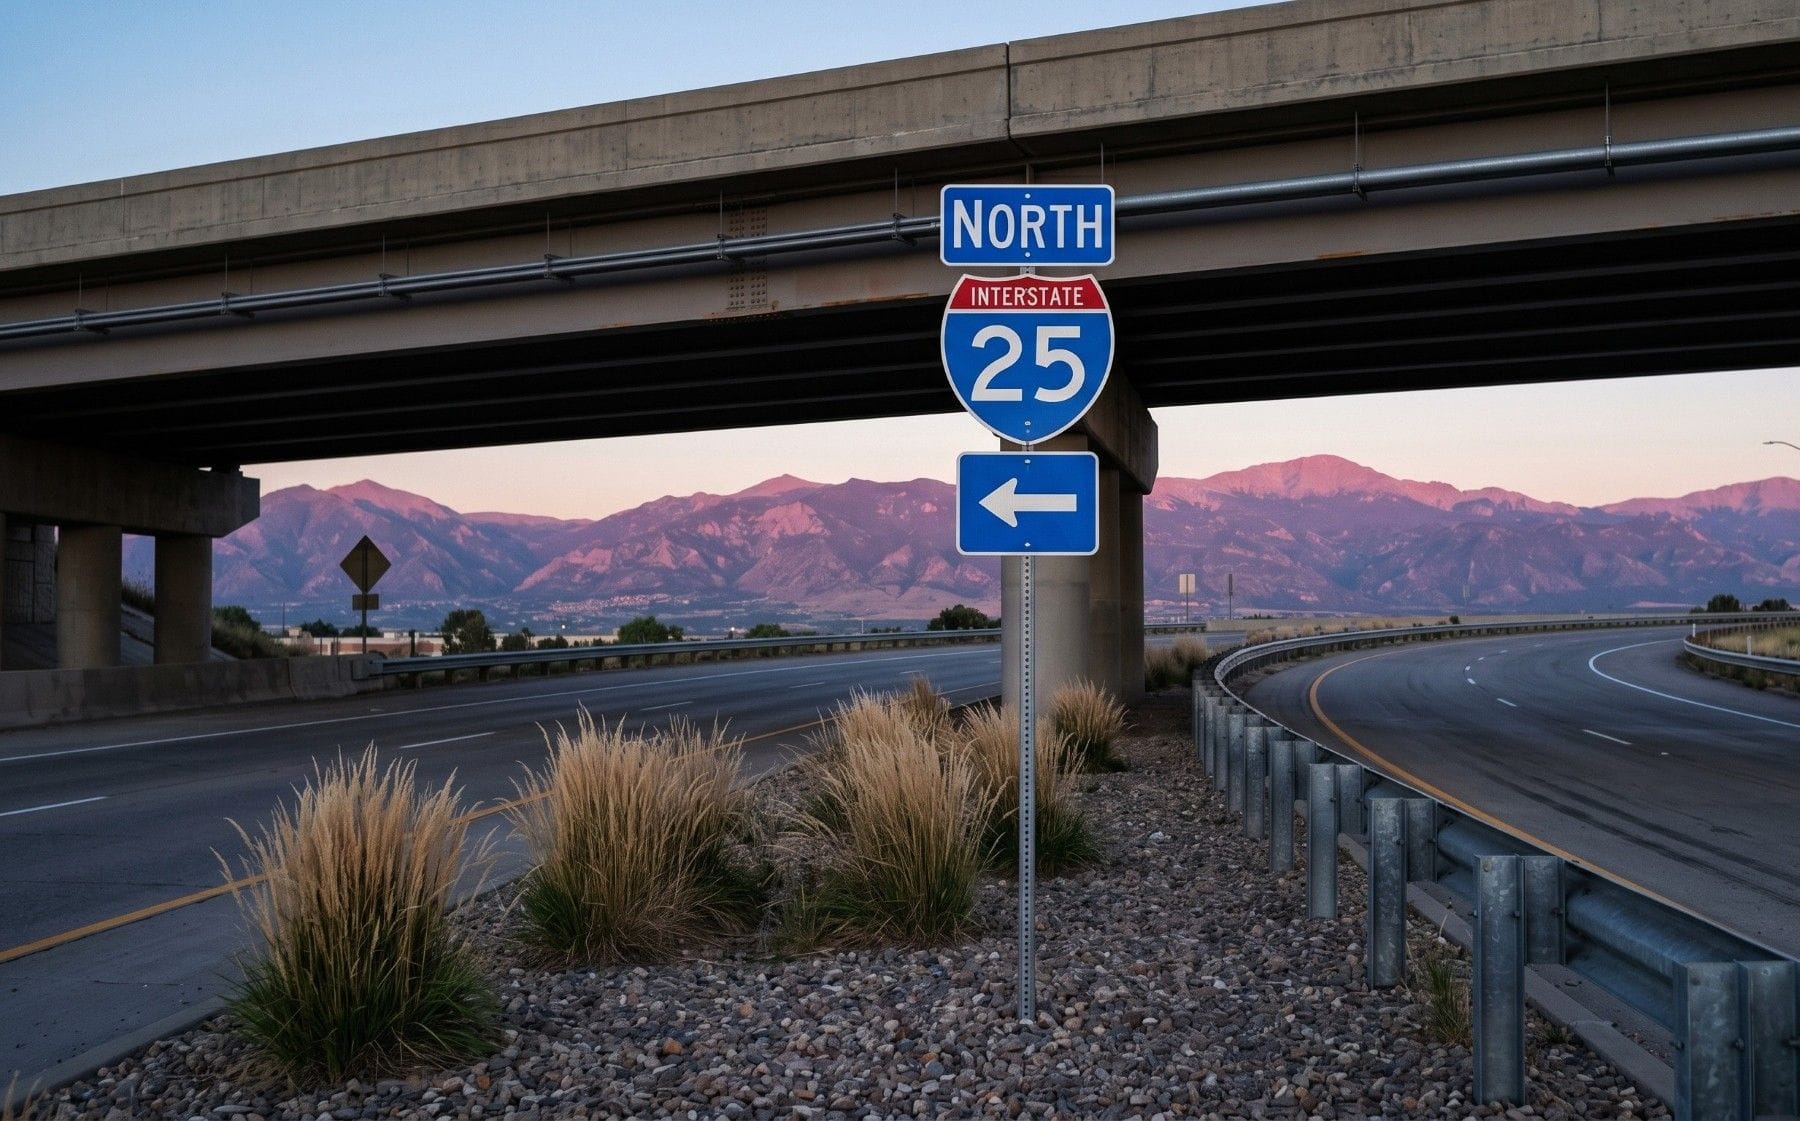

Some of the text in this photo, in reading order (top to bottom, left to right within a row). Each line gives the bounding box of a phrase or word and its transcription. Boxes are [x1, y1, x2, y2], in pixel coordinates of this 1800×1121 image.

[953, 199, 1103, 249] NORTH
[971, 287, 1084, 306] INTERSTATE
[971, 324, 1086, 403] 25
